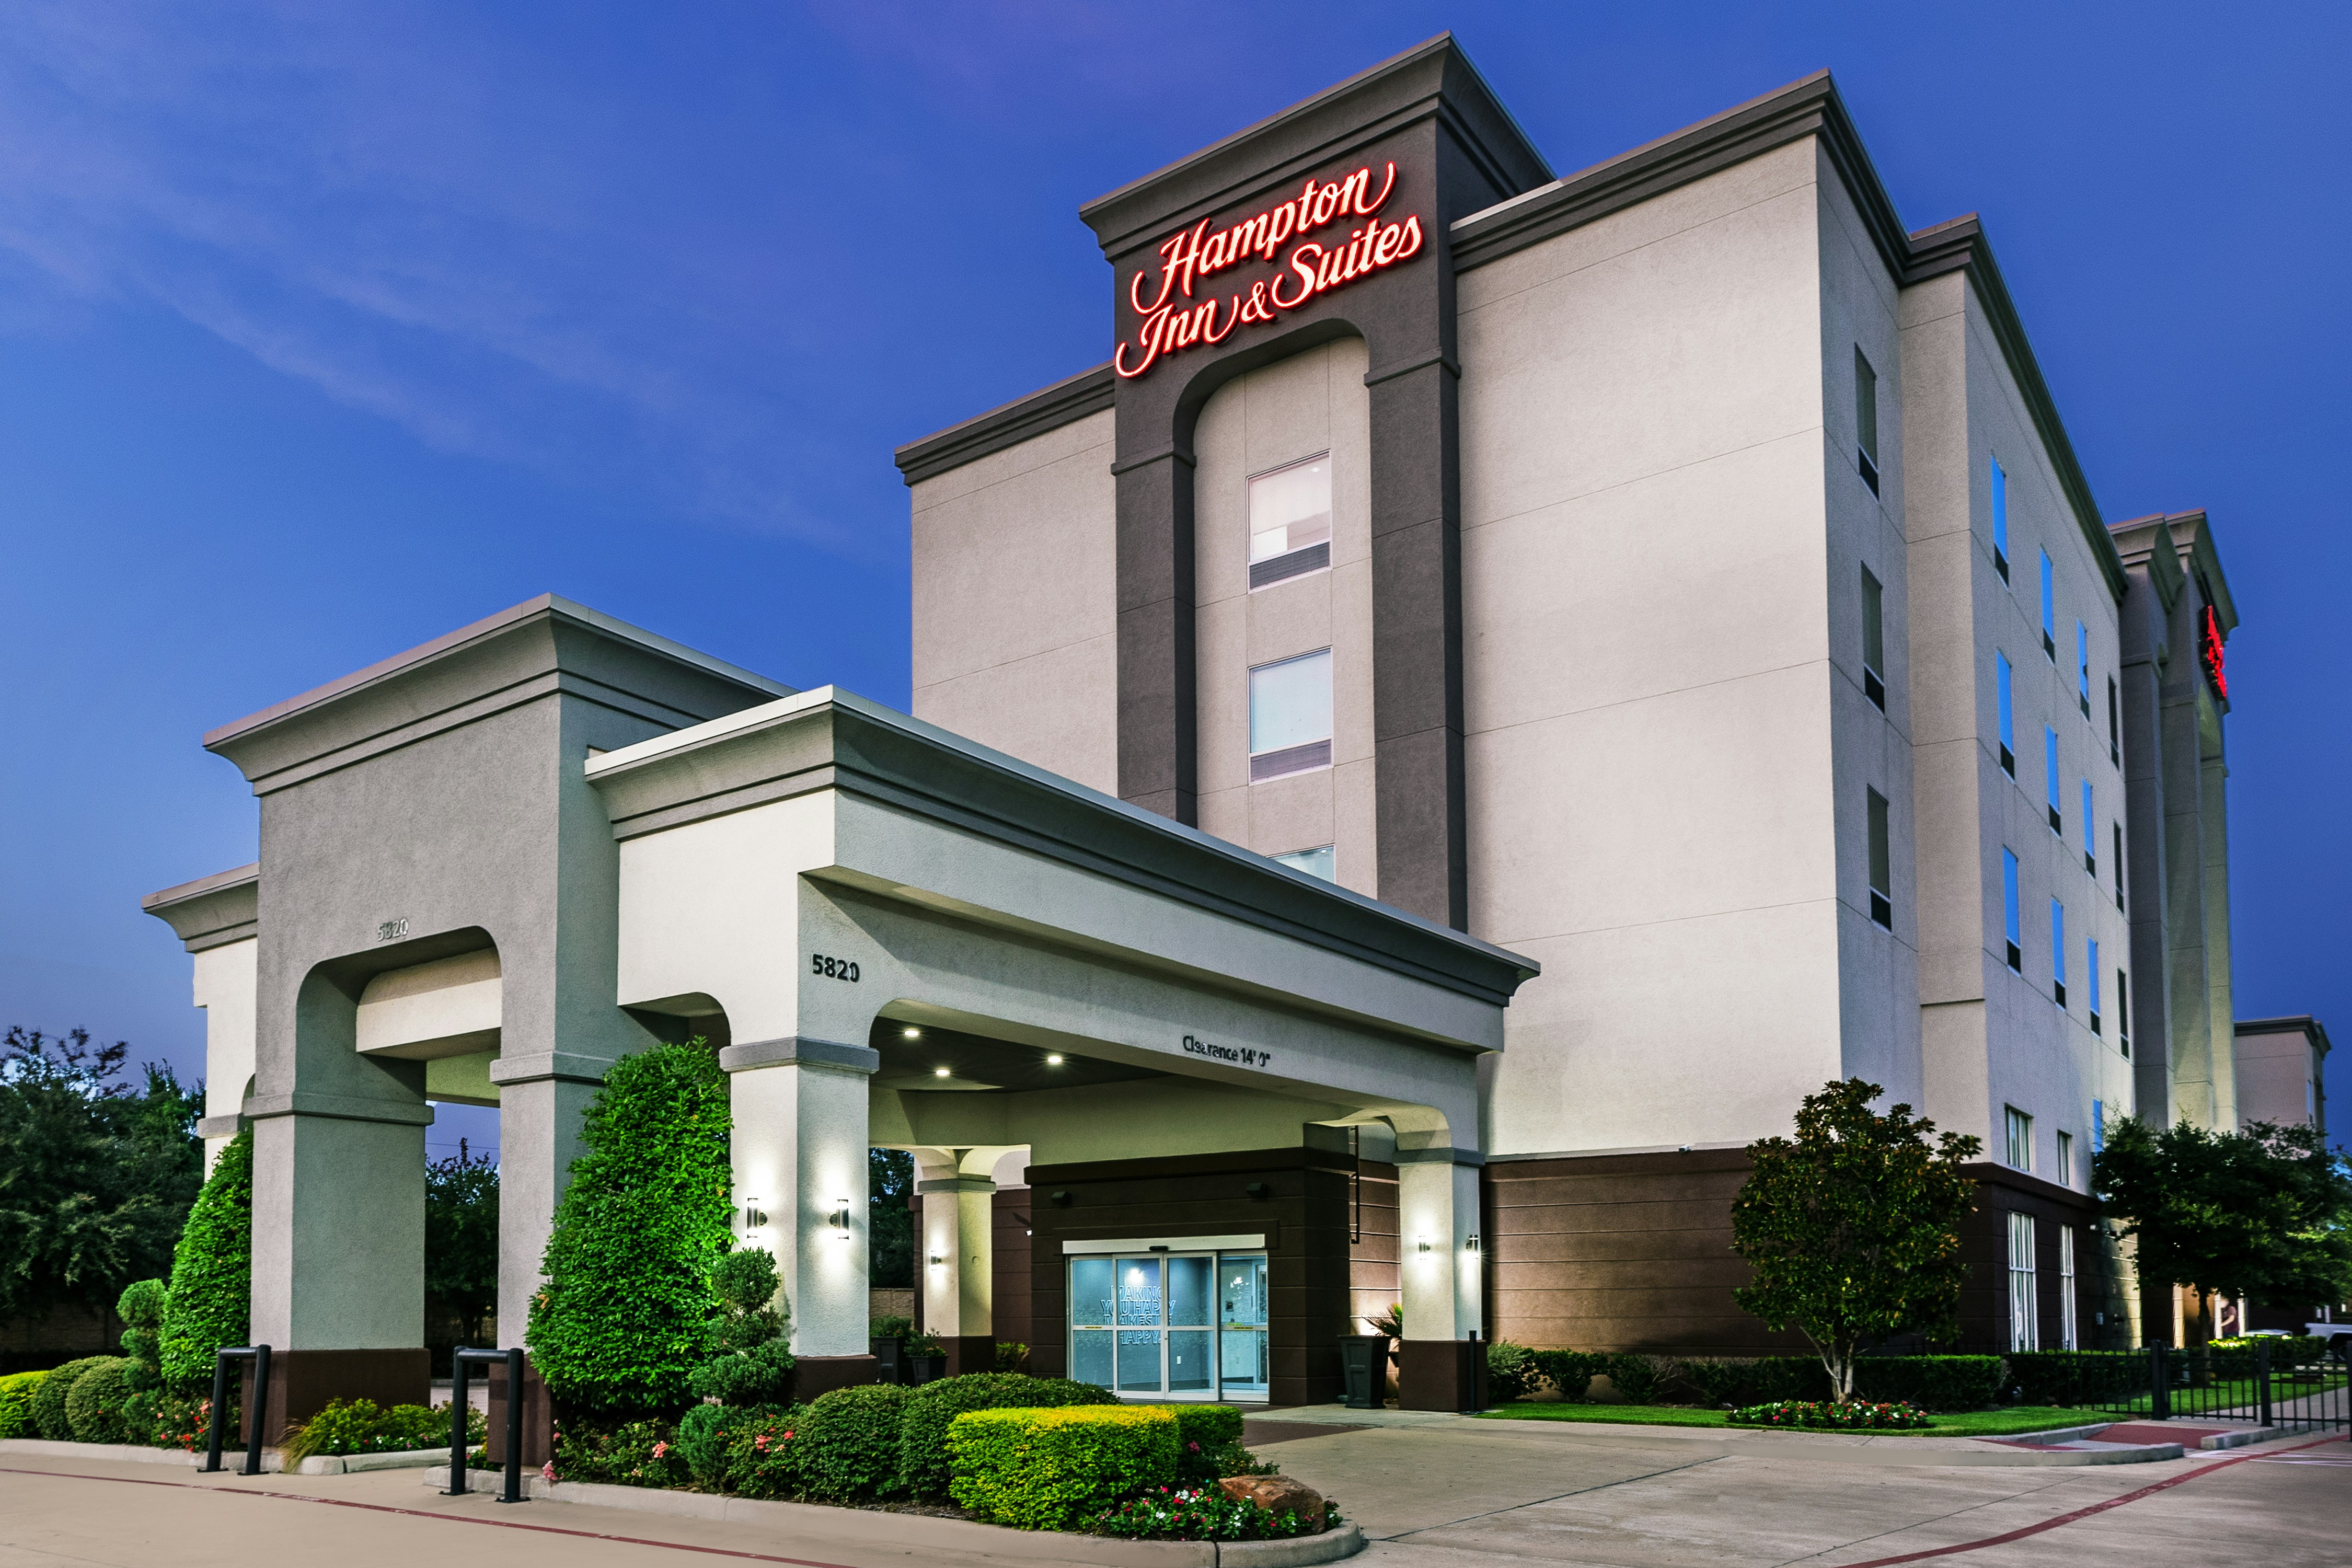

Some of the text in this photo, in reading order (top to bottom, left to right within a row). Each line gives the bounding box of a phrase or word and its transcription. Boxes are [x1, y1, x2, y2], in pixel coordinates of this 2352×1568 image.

[1130, 160, 1396, 315] Hampton
[1114, 213, 1423, 379] Inn & Suites
[377, 918, 409, 942] 5820
[812, 953, 860, 983] 5820
[1182, 1035, 1239, 1062] Clearance
[1133, 1299, 1177, 1316] HAPY
